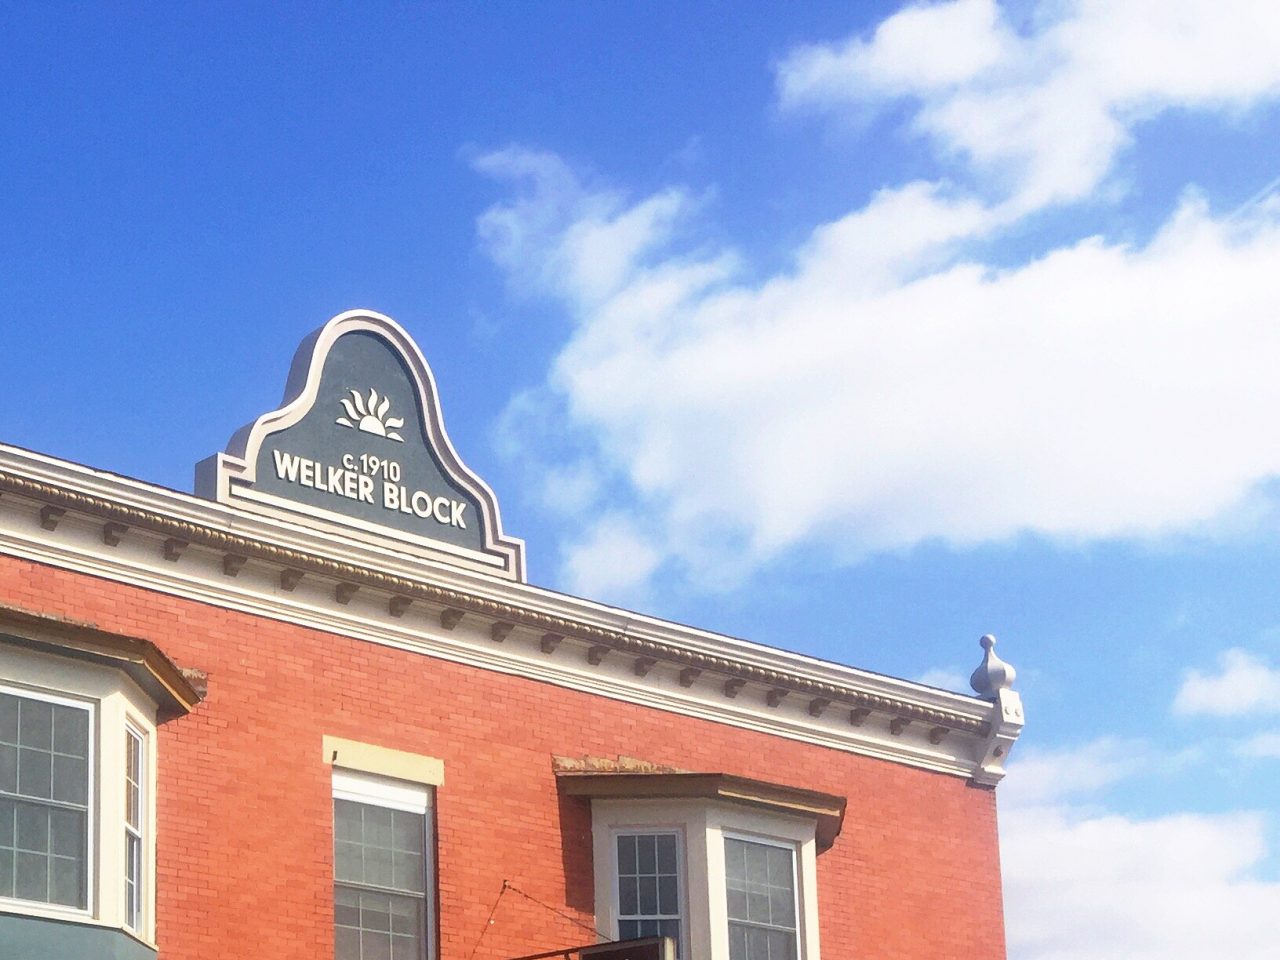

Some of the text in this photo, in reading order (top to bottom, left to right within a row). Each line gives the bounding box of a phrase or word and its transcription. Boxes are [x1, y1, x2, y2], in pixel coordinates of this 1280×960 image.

[273, 449, 467, 529] WELKER BLOCK
[342, 453, 401, 483] c.1910
